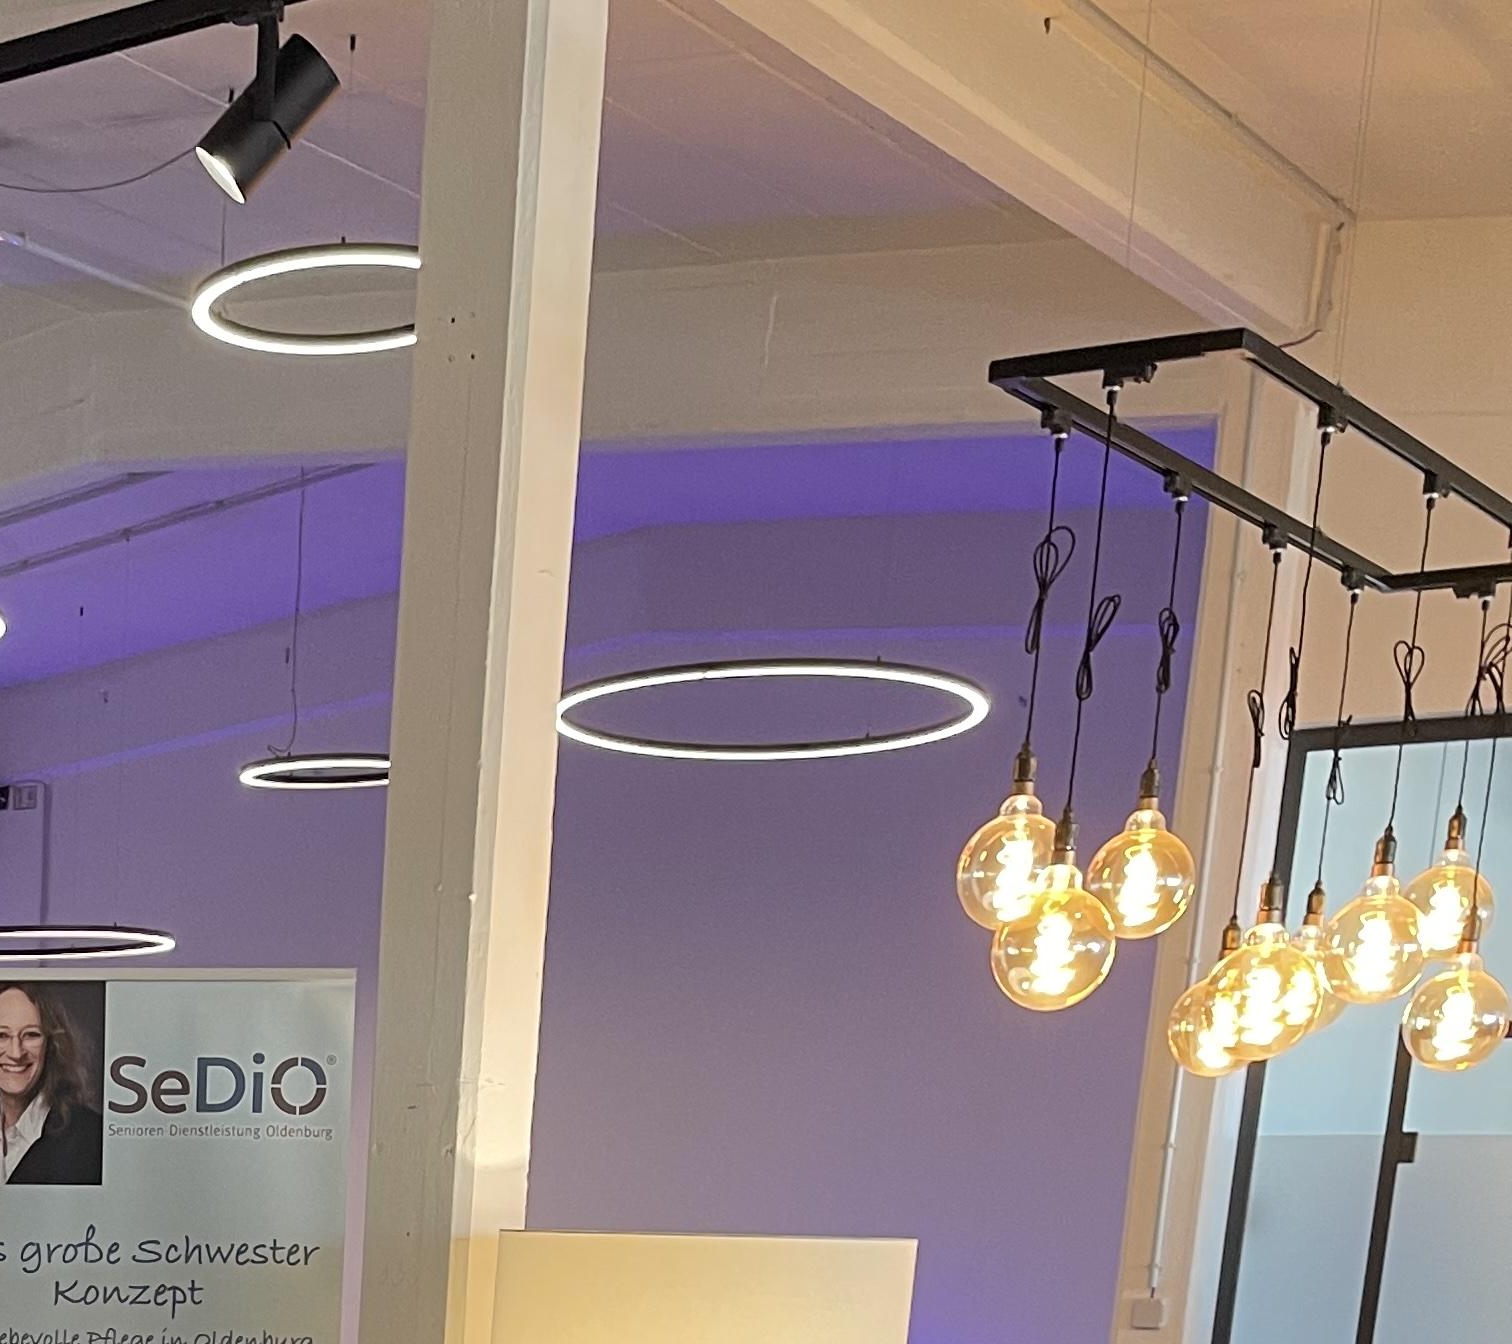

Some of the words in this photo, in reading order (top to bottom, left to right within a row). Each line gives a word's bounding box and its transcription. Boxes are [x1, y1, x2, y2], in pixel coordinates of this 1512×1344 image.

[108, 1052, 327, 1116] SeDiO
[108, 1123, 164, 1137] Senioren
[169, 1123, 261, 1140] Dienstleistung
[266, 1124, 333, 1141] Oldenburg
[20, 1223, 121, 1274] große
[132, 1235, 321, 1266] Schwester
[54, 1279, 204, 1320] Konzept
